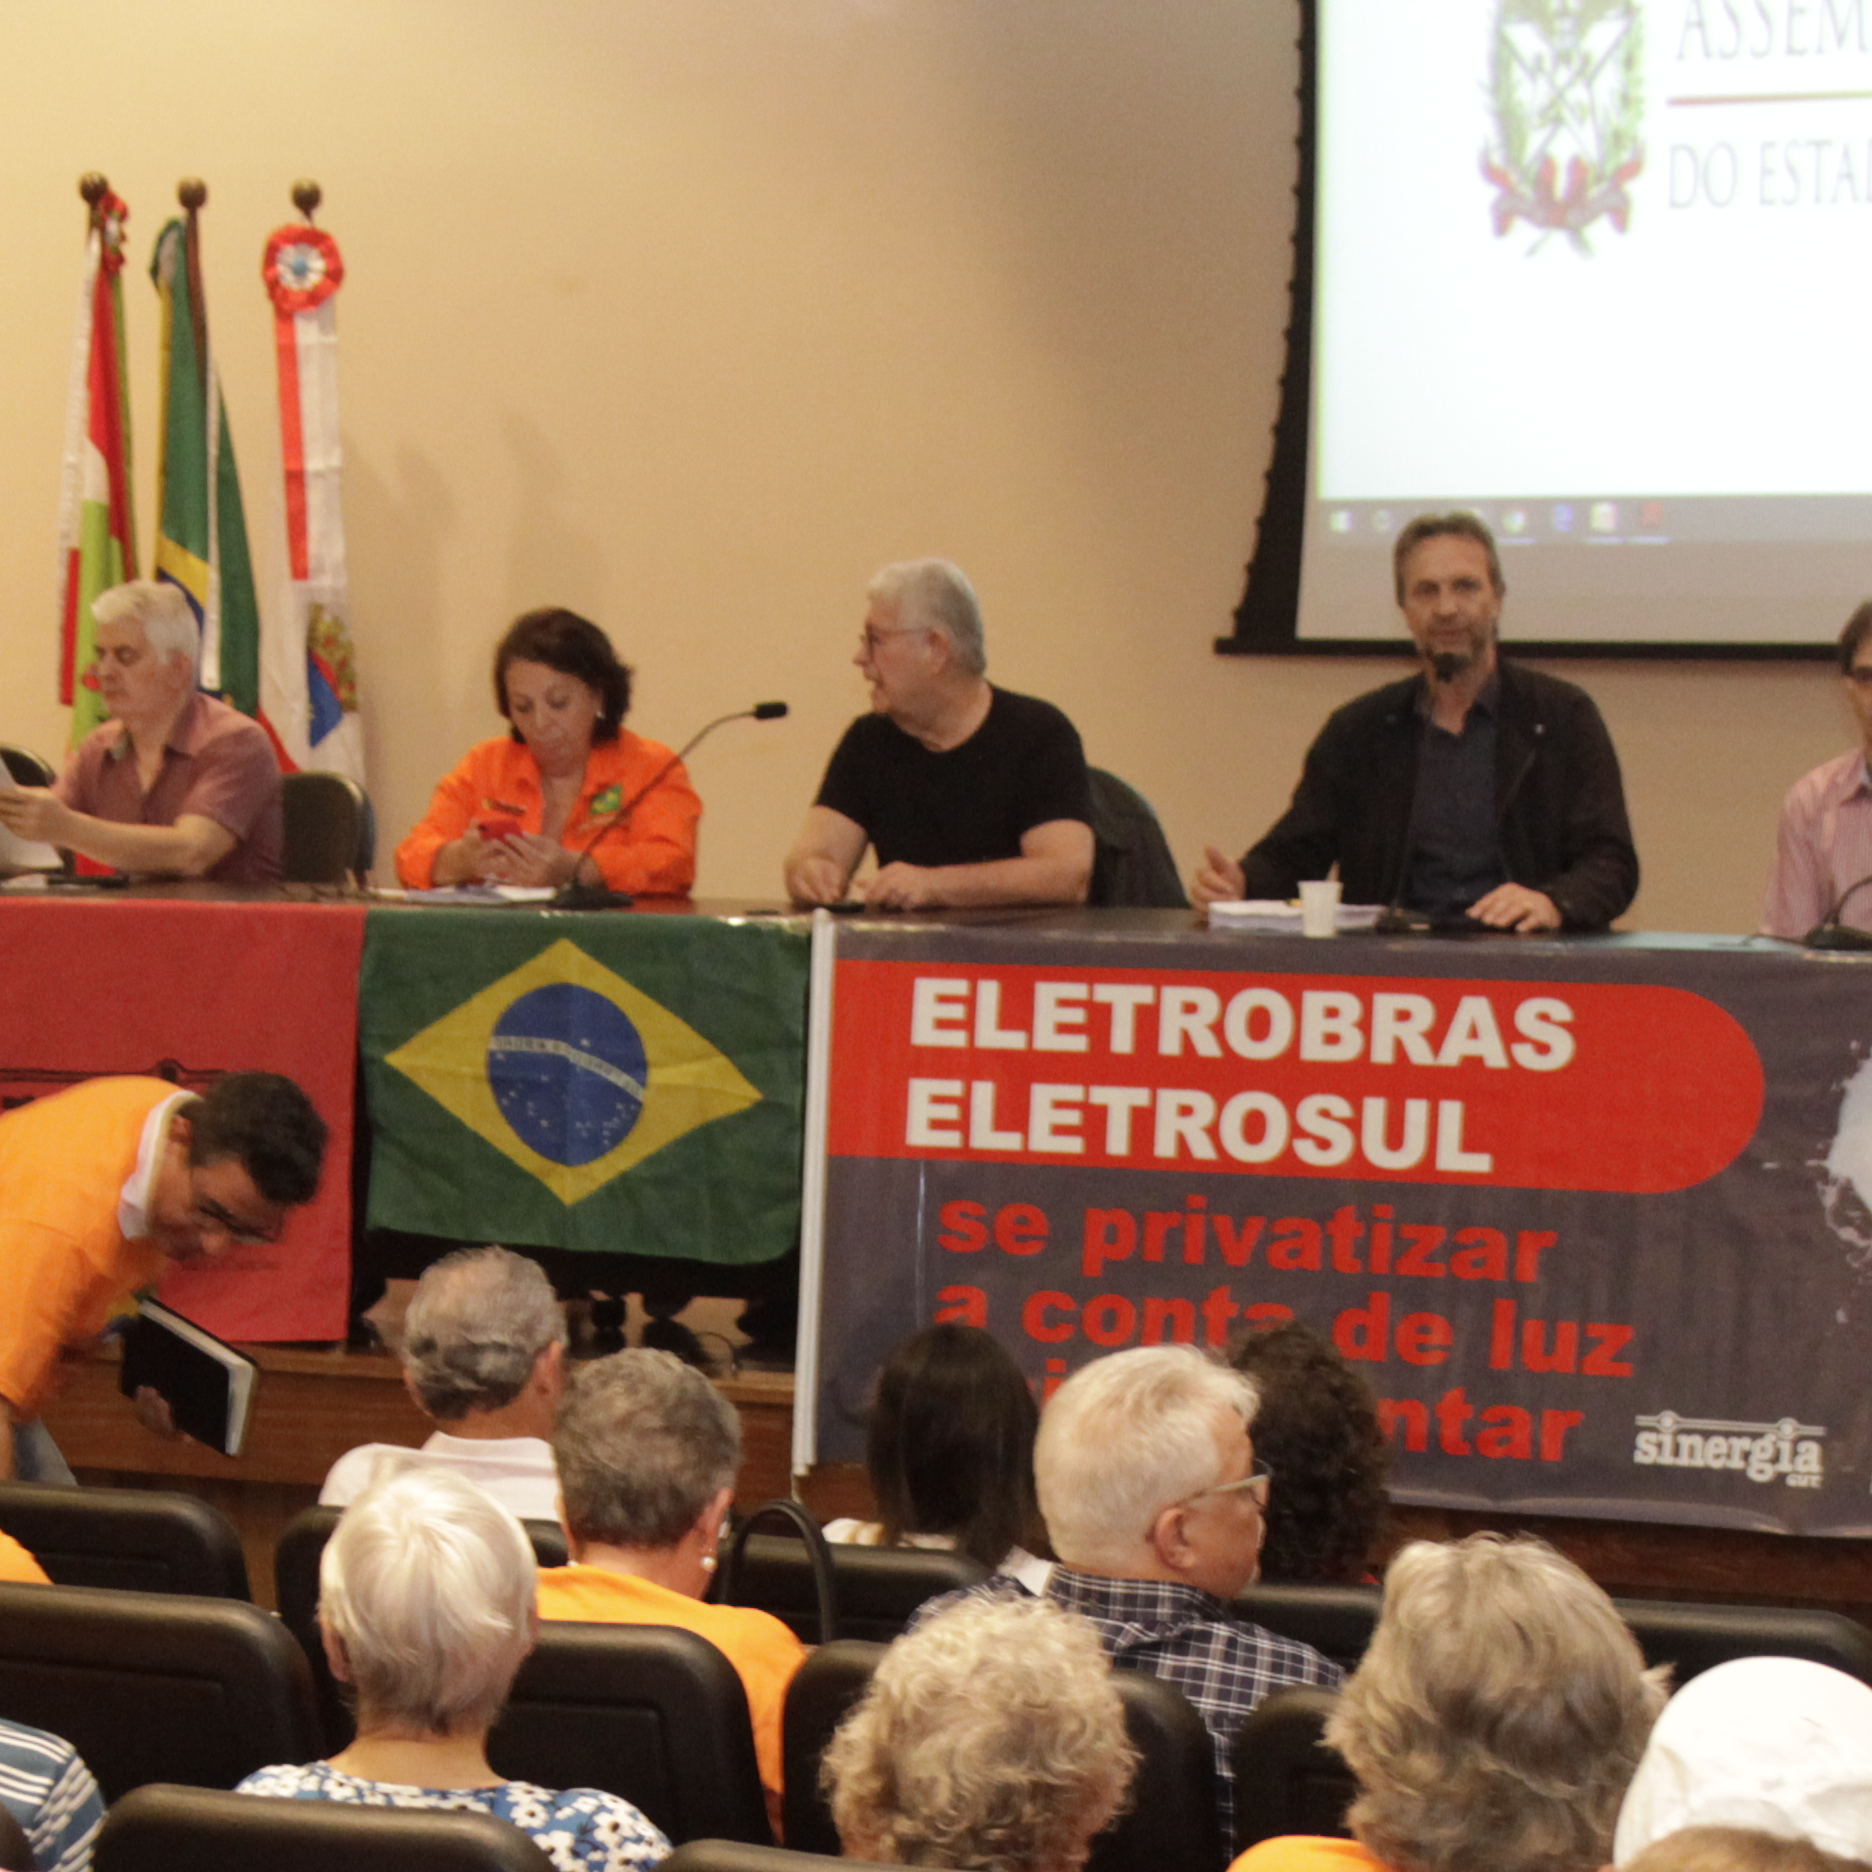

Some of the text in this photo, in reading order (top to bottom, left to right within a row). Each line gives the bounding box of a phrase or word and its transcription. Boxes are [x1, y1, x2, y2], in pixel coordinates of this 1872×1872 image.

[1667, 142, 1740, 210] DO
[909, 976, 1576, 1072] ELETROBRAS
[904, 1077, 1494, 1174] ELETROSUL
[936, 1194, 1559, 1284] se privatizar
[934, 1283, 988, 1331] a
[1332, 1291, 1455, 1367] de
[1489, 1298, 1636, 1378] luz
[1633, 1430, 1825, 1484] sinergia
